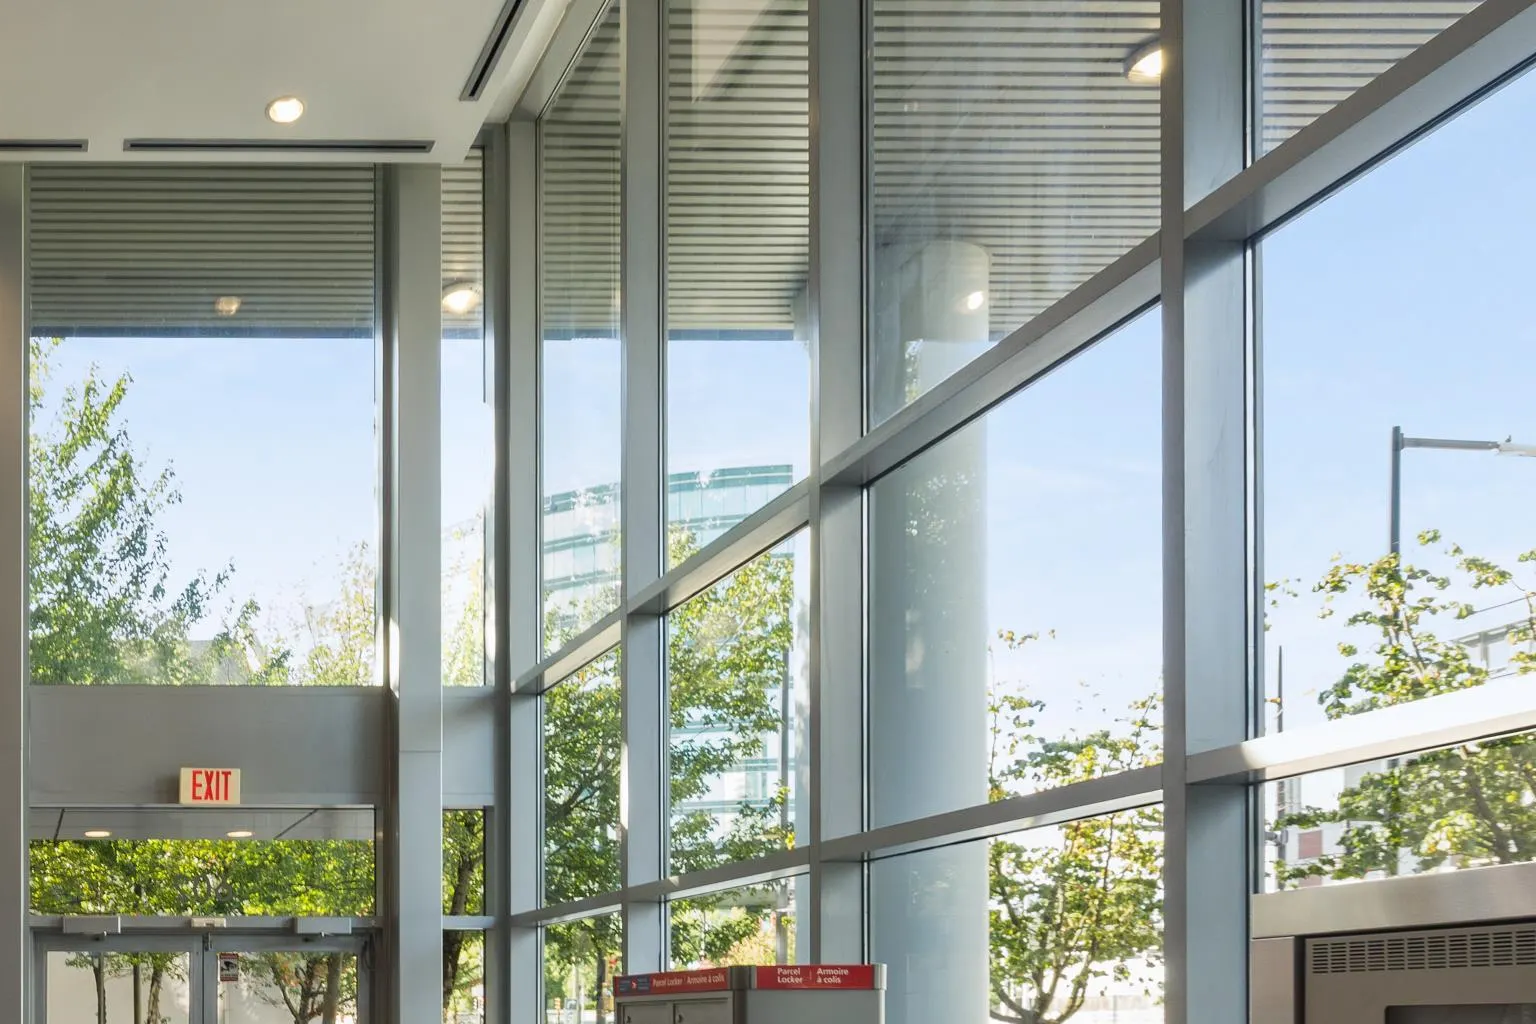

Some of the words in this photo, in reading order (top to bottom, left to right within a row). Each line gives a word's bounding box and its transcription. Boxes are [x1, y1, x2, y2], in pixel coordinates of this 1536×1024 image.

[191, 769, 232, 801] EXIT
[652, 978, 666, 987] Parcel
[667, 978, 683, 986] Locker
[687, 975, 707, 985] Armoire
[712, 973, 725, 983] colis
[777, 975, 803, 984] Locker
[816, 975, 823, 984] à
[823, 975, 842, 984] colis
